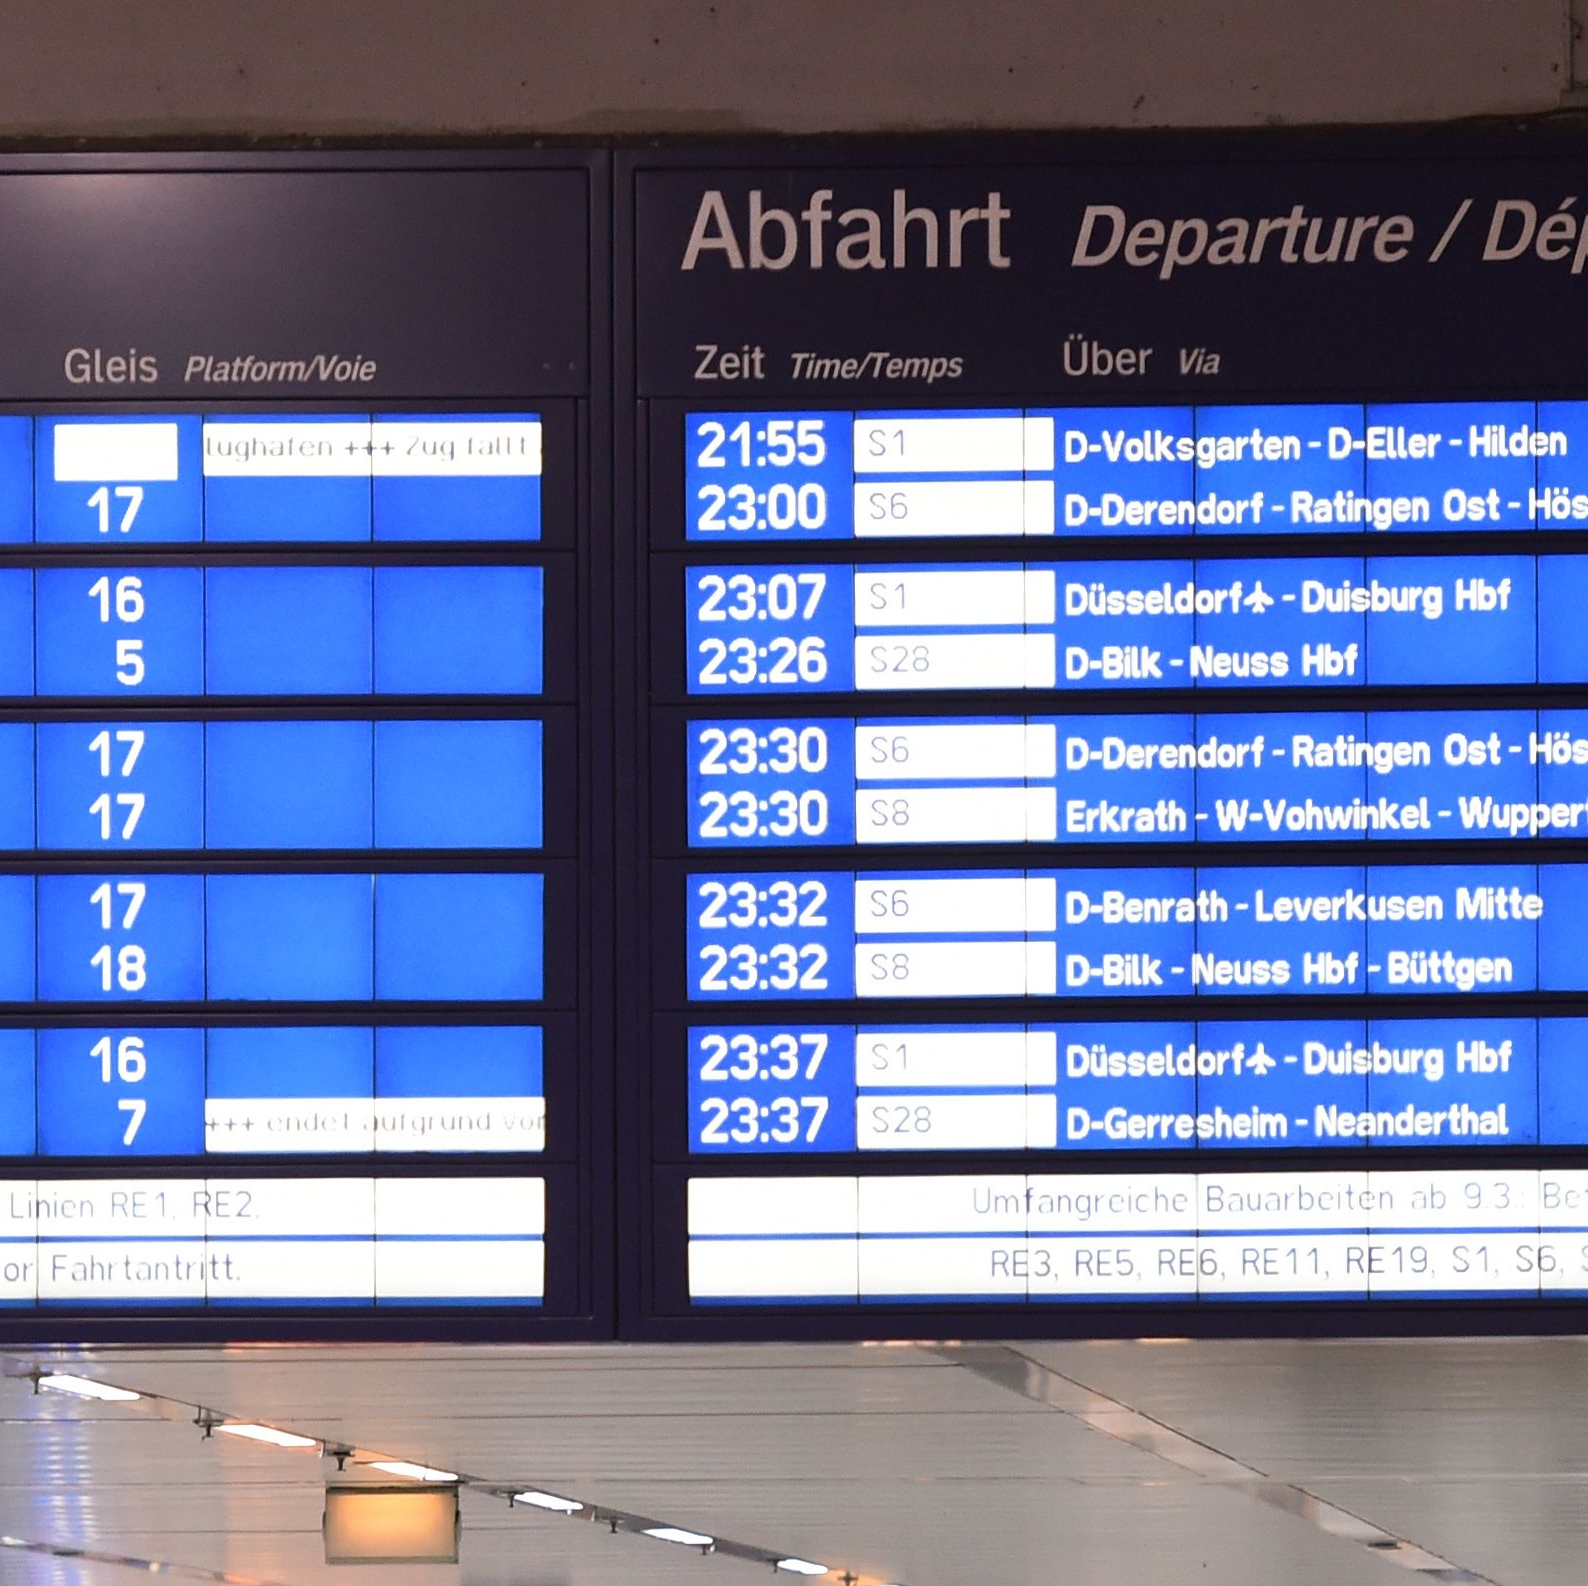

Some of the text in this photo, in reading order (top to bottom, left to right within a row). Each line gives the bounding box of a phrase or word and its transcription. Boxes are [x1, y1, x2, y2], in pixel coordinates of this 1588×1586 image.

[682, 190, 1010, 270] Abfahrt
[1072, 206, 1413, 279] Departure
[65, 347, 158, 384] Gleis
[184, 355, 376, 384] Platform/Voie
[695, 345, 764, 379] Zeit
[792, 352, 962, 382] Time/Temps
[1064, 334, 1152, 375] Über
[1181, 349, 1220, 373] Via
[698, 420, 825, 467] 21:55
[869, 430, 903, 456] S1
[88, 486, 143, 532] 17
[698, 483, 826, 530] 23:00
[870, 493, 908, 519] S6
[89, 577, 144, 622] 16
[699, 573, 826, 621] 23:07
[871, 583, 905, 609] S1
[117, 640, 144, 685] 5
[699, 637, 827, 684] 23:26
[871, 646, 930, 672] S28
[89, 731, 144, 776] 17
[700, 727, 827, 774] 23:30
[90, 793, 145, 839] 17
[700, 790, 828, 837] 23:30
[91, 883, 145, 929] 17
[700, 881, 827, 928] 23:32
[91, 945, 146, 991] 18
[700, 944, 827, 990] 23:32
[91, 1037, 146, 1082] 16
[700, 1034, 828, 1080] 23:37
[118, 1099, 146, 1145] 7
[701, 1097, 828, 1143] 23:37
